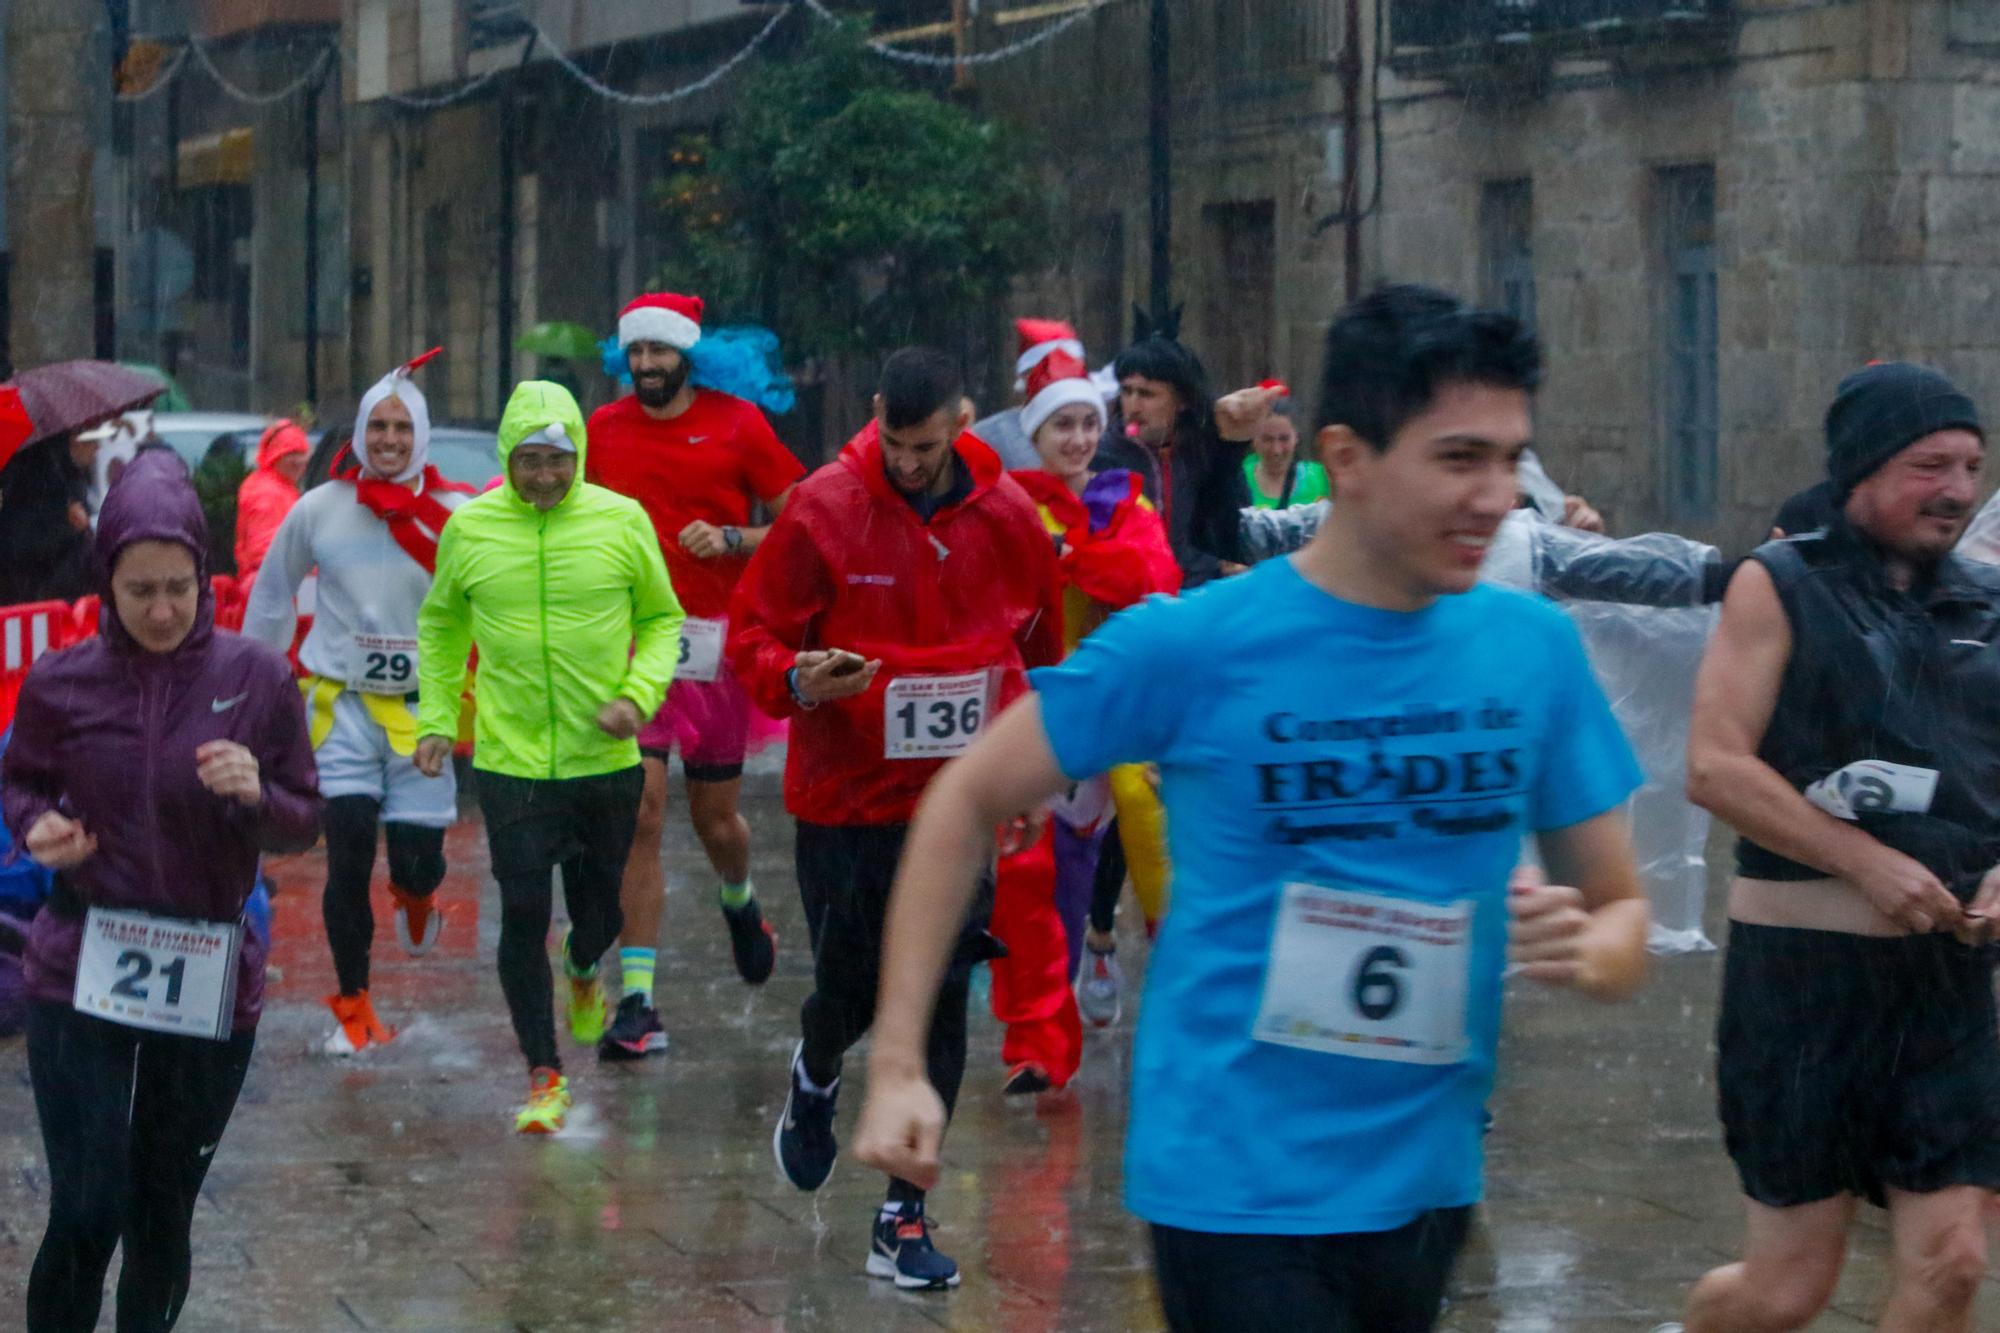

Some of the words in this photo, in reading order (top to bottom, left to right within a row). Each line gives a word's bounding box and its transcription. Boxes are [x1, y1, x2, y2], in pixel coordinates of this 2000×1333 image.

[366, 652, 411, 681] 29
[897, 698, 980, 739] 136
[110, 949, 186, 1007] 21
[1352, 946, 1413, 1021] 6
